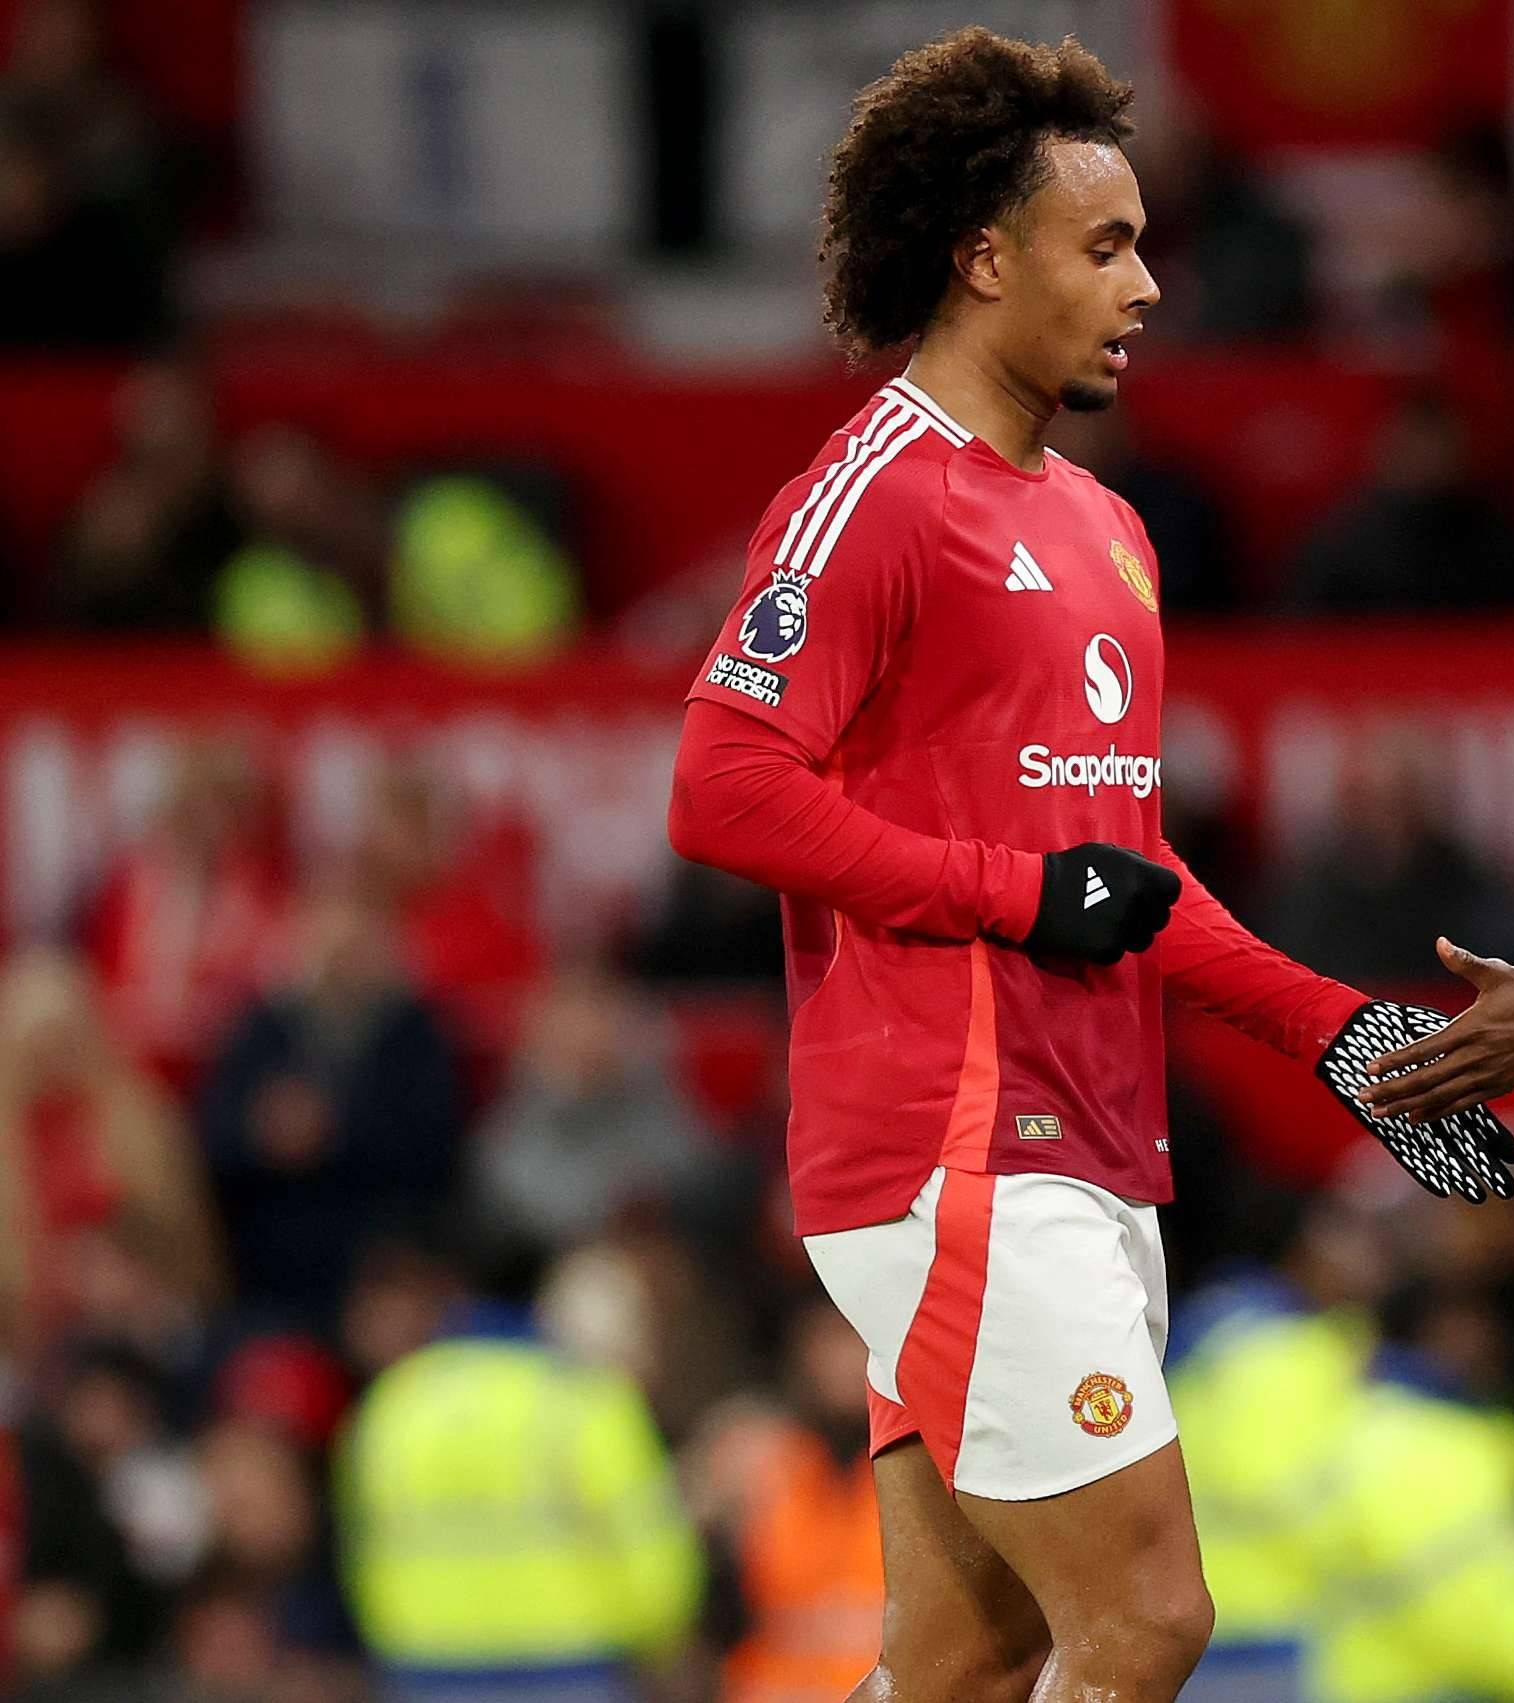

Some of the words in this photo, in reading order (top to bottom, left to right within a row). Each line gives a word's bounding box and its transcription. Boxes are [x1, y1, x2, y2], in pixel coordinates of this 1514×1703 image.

[714, 653, 735, 672] No
[732, 661, 780, 690] room
[724, 673, 780, 707] racism
[1073, 1377, 1124, 1407] MANCHESTER
[1093, 1414, 1128, 1434] UNITED
